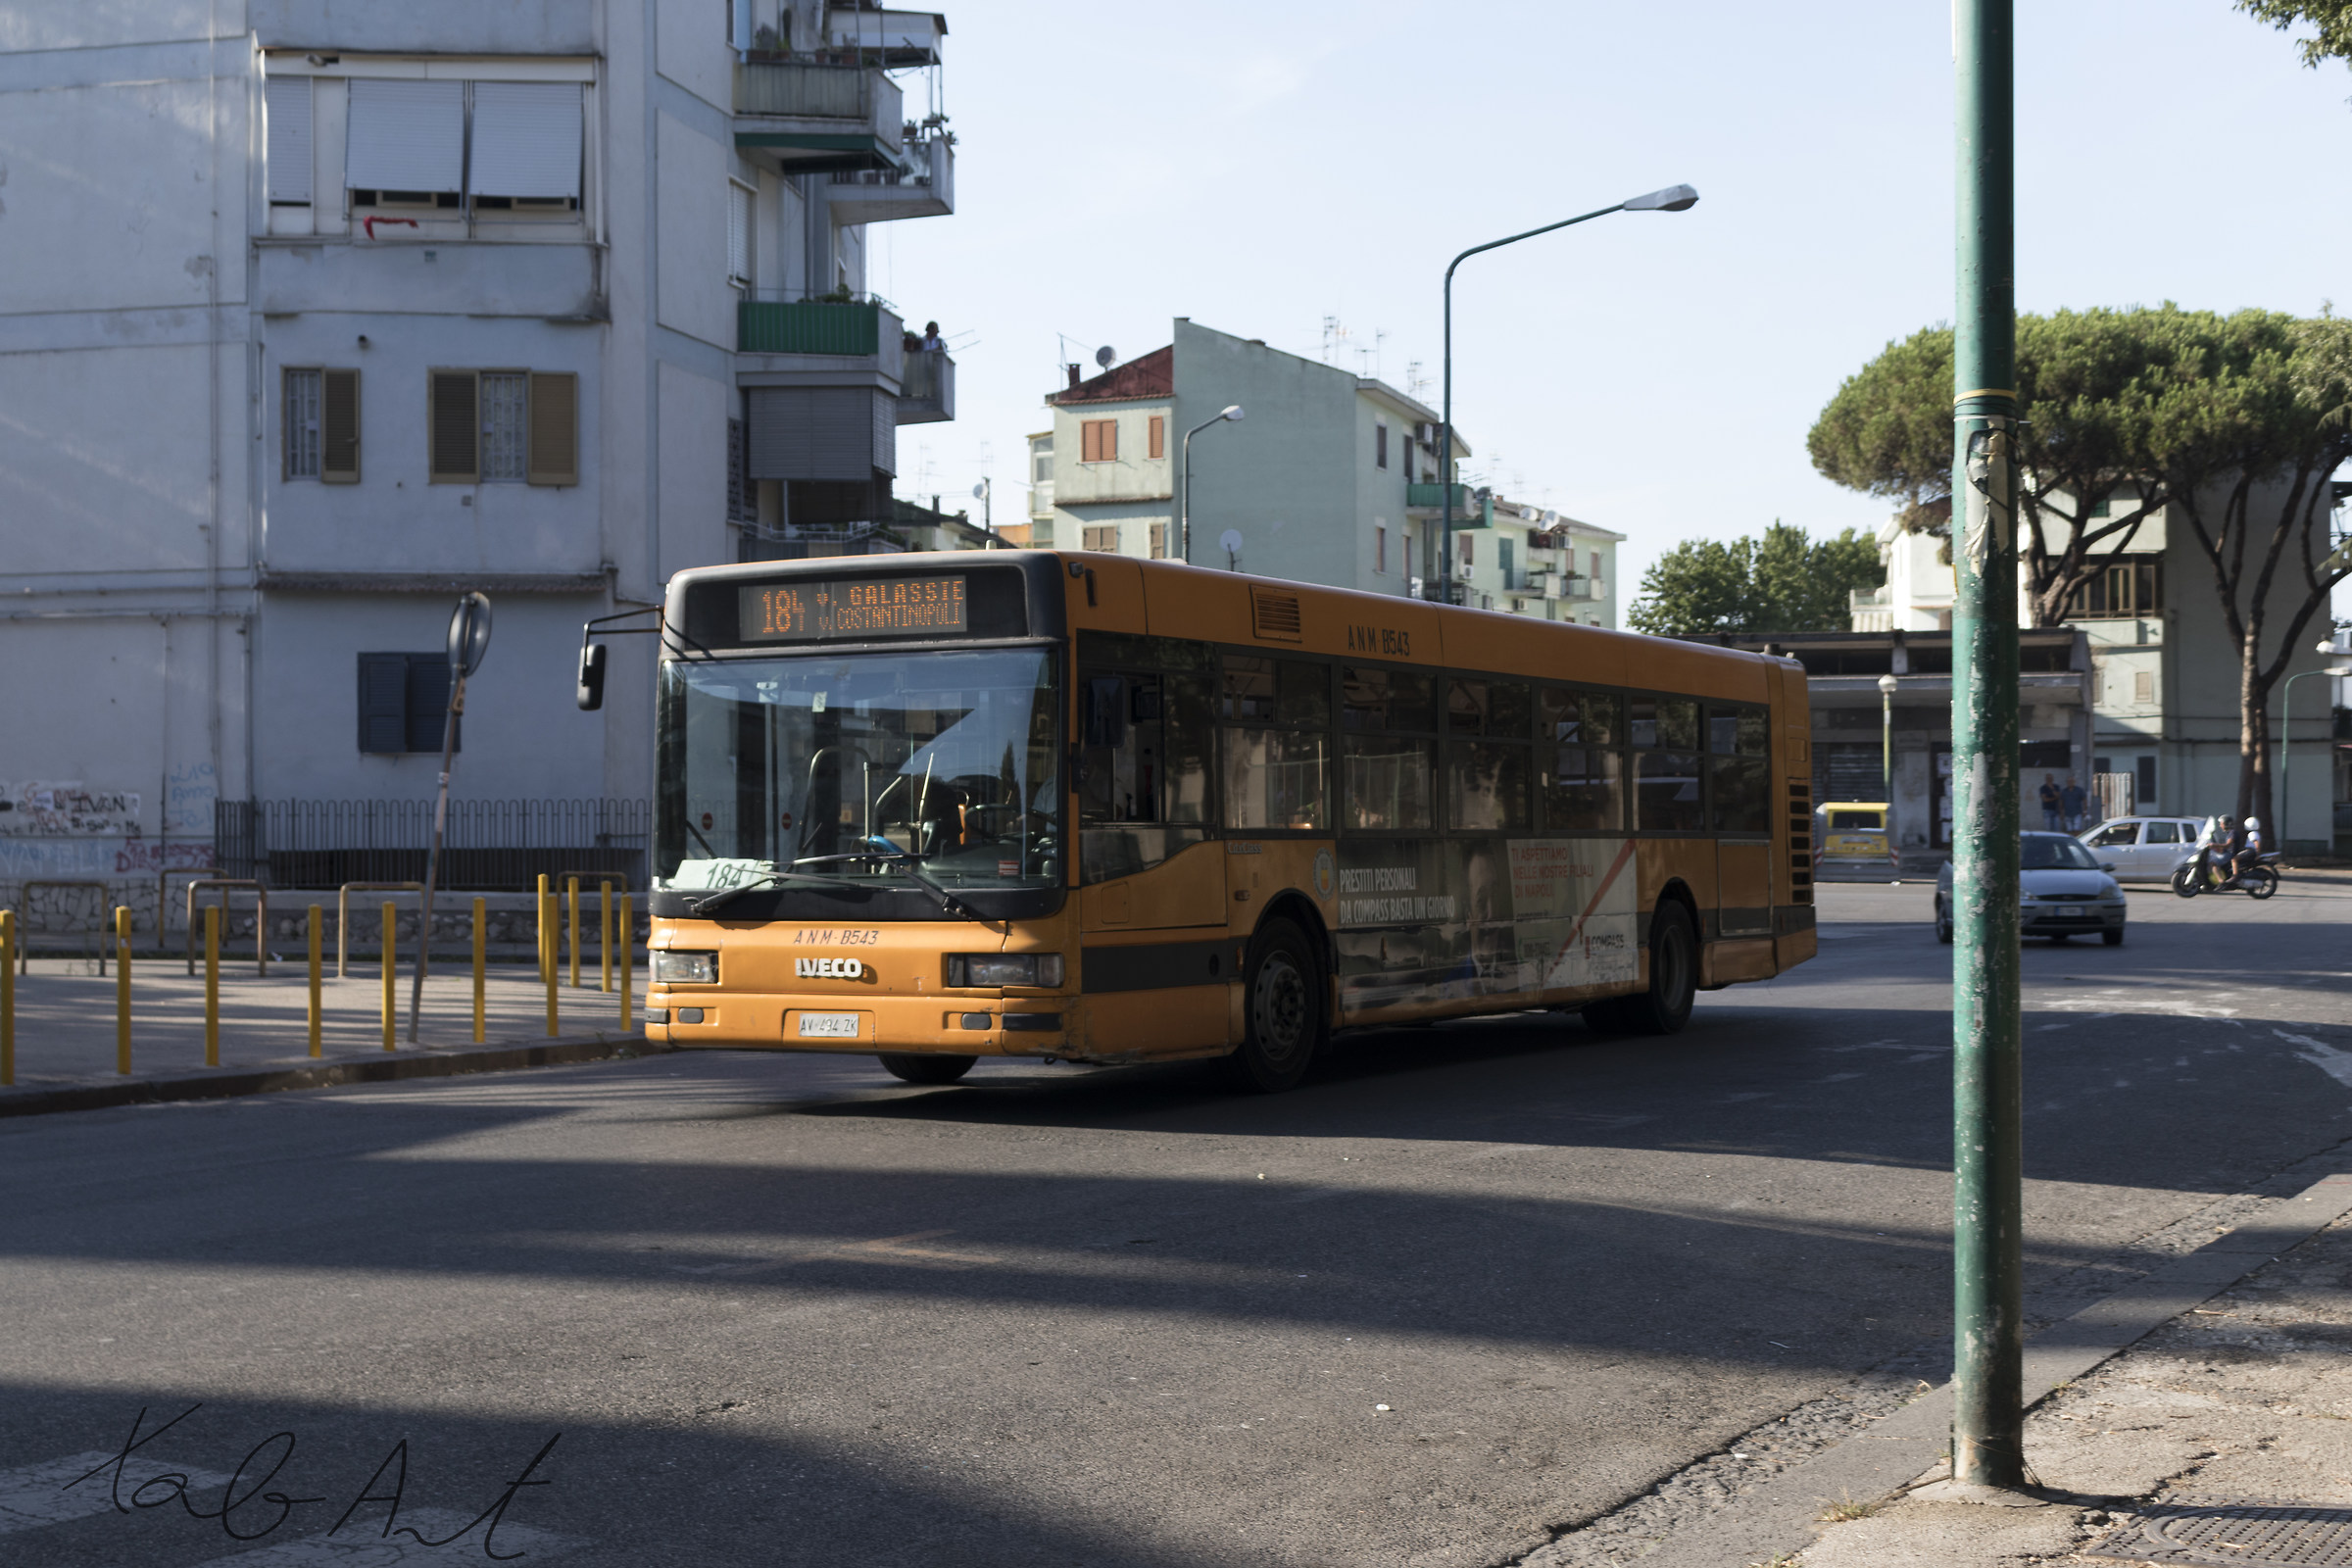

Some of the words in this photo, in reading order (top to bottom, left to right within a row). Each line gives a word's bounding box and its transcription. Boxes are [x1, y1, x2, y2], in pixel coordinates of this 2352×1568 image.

[761, 589, 807, 634] 184
[850, 580, 963, 606] GALASSIE
[1520, 847, 1569, 861] ASPETTIAMO
[1339, 868, 1374, 893] PRESTITI
[1512, 865, 1538, 880] NELLE
[1538, 864, 1569, 879] NOSTRE
[1340, 899, 1352, 924] DA
[1353, 898, 1390, 923] COMPASS
[1390, 897, 1413, 921] BASTA
[1414, 896, 1426, 919] UN
[794, 957, 862, 978] IVECO
[800, 1018, 813, 1032] AV
[844, 1017, 858, 1032] ZK
